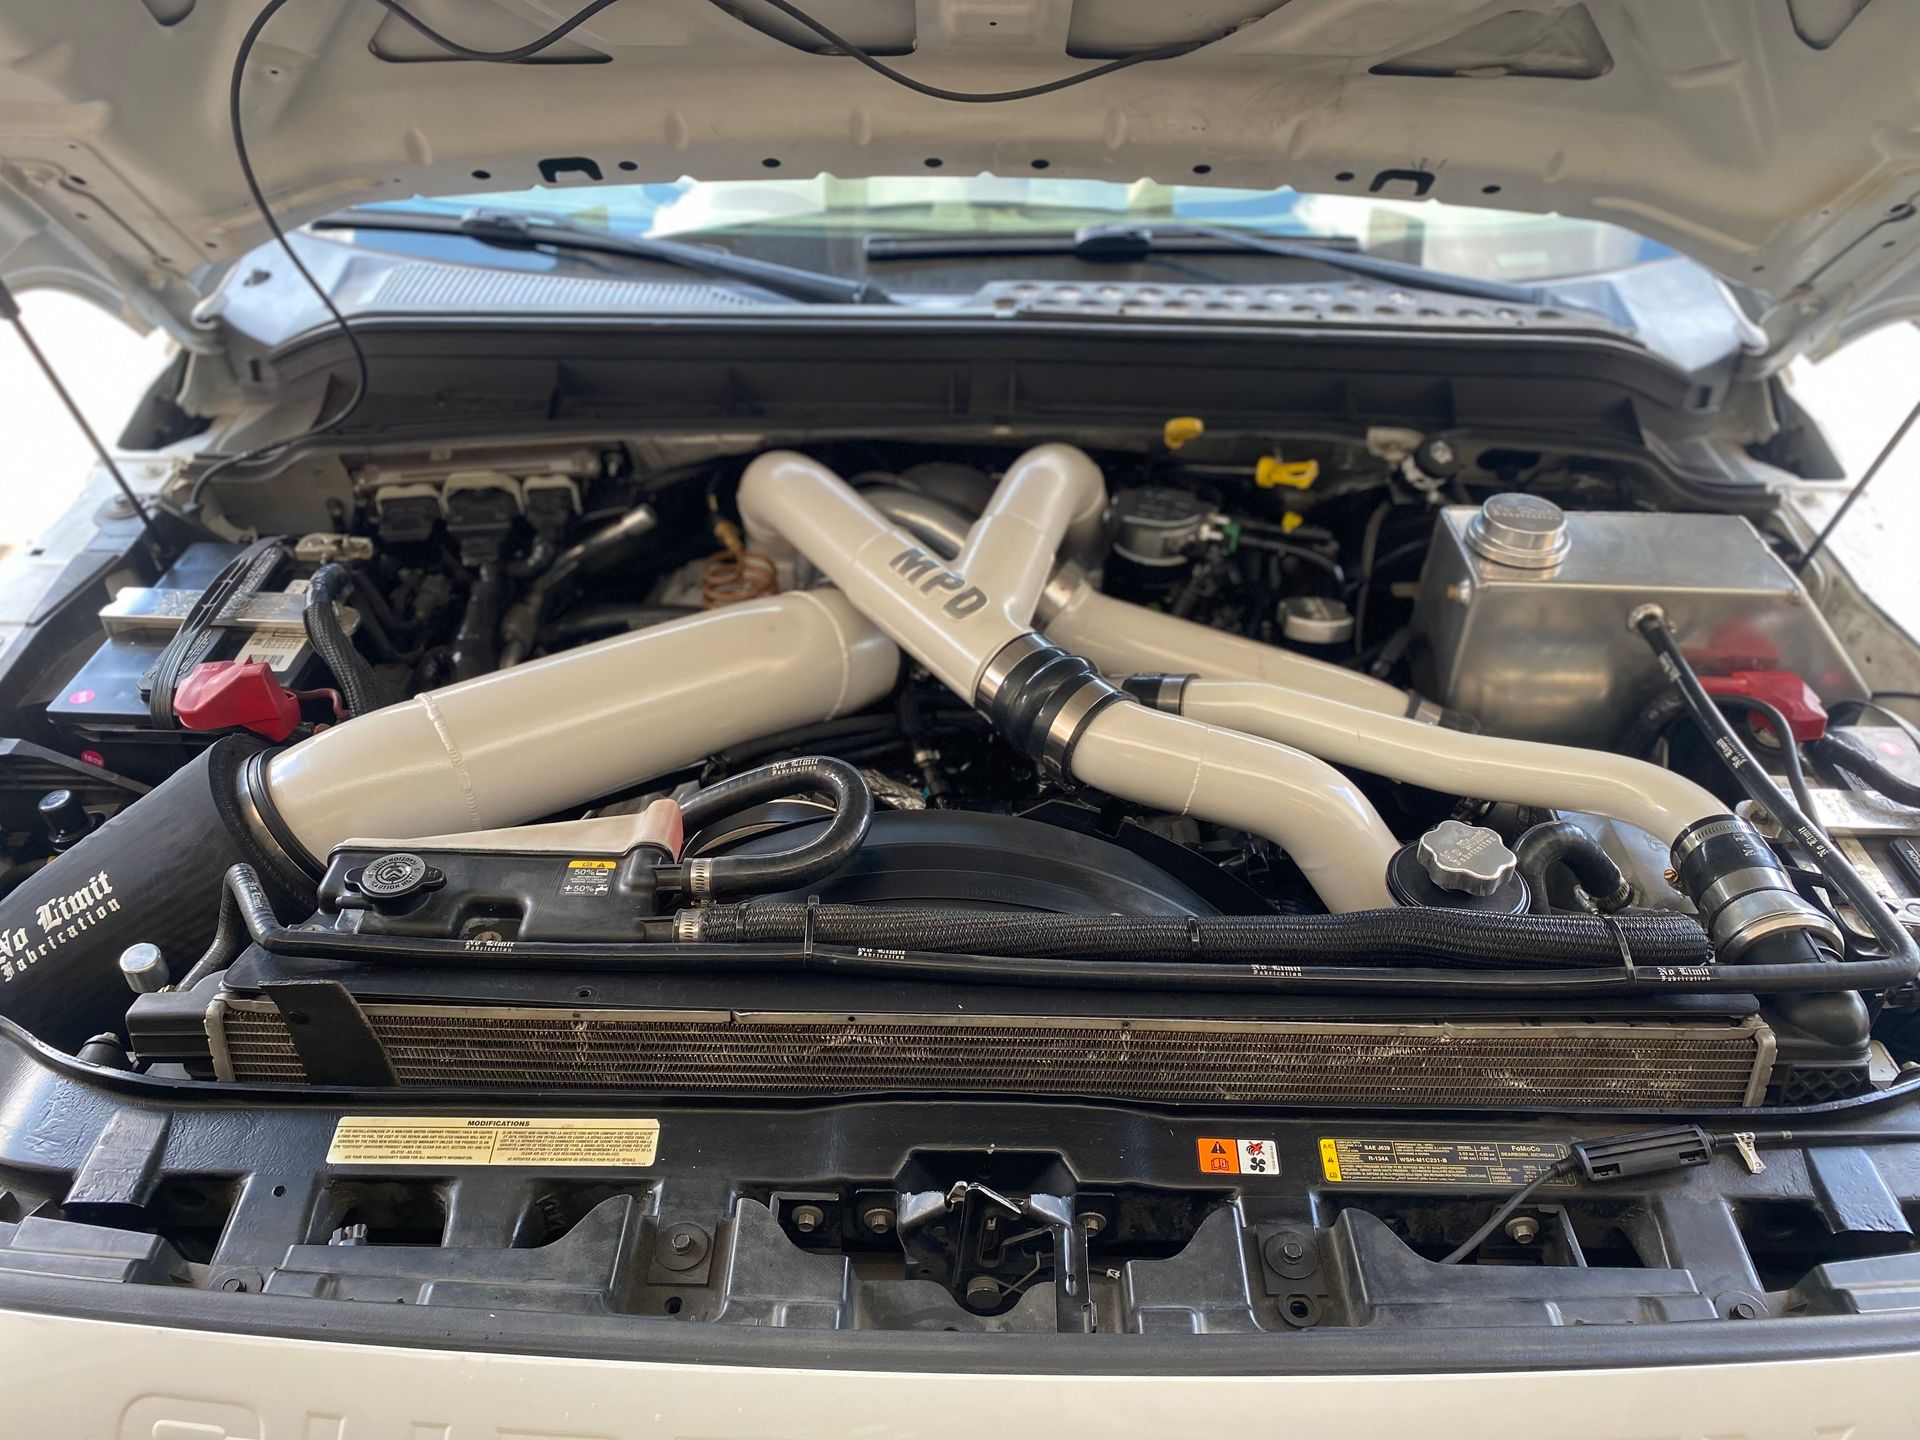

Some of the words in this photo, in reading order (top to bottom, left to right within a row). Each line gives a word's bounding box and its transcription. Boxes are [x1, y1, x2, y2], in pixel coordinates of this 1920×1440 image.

[889, 548, 989, 619] MPD
[790, 757, 819, 767] Limit
[35, 870, 113, 934] Limit
[0, 898, 121, 982] Fabrication
[1253, 969, 1302, 977] Fabrication
[1657, 967, 1674, 976] No
[1678, 967, 1711, 976] Limit
